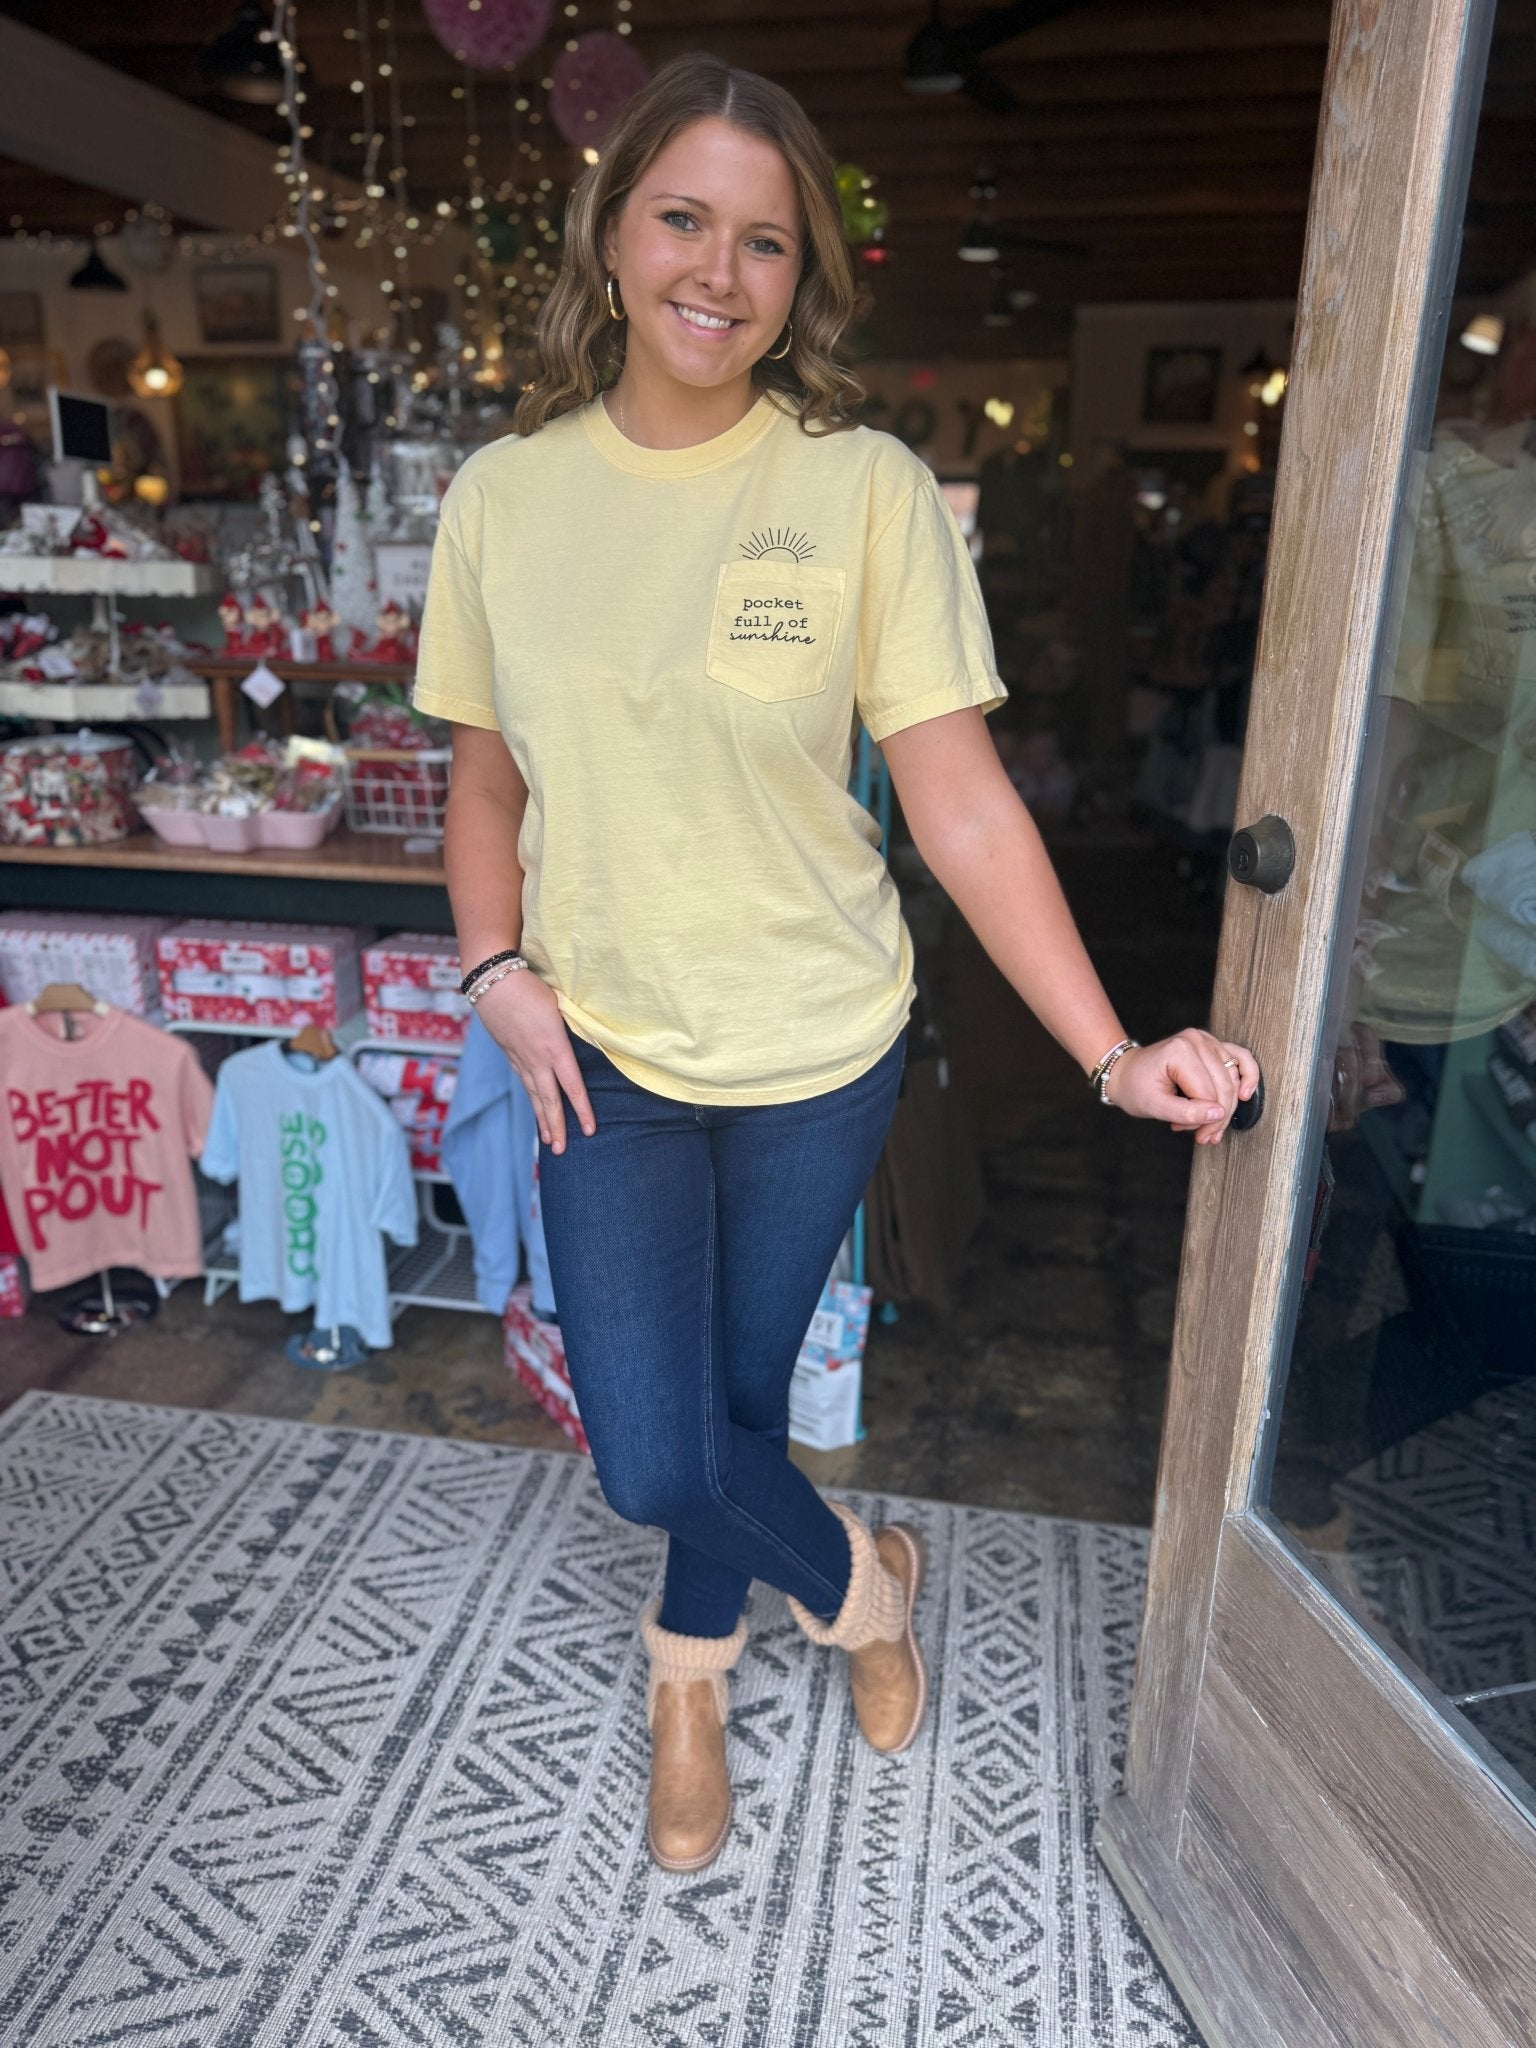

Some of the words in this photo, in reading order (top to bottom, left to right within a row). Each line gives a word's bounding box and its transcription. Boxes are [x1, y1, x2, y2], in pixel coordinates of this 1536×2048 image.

[734, 615, 772, 627] full
[788, 617, 808, 629] of
[742, 597, 804, 611] pocket
[729, 621, 816, 644] sunshine
[7, 1078, 161, 1143] BETTER
[36, 1128, 142, 1184] NOT
[23, 1174, 163, 1252] POUT
[278, 1110, 317, 1278] CHOOSE
